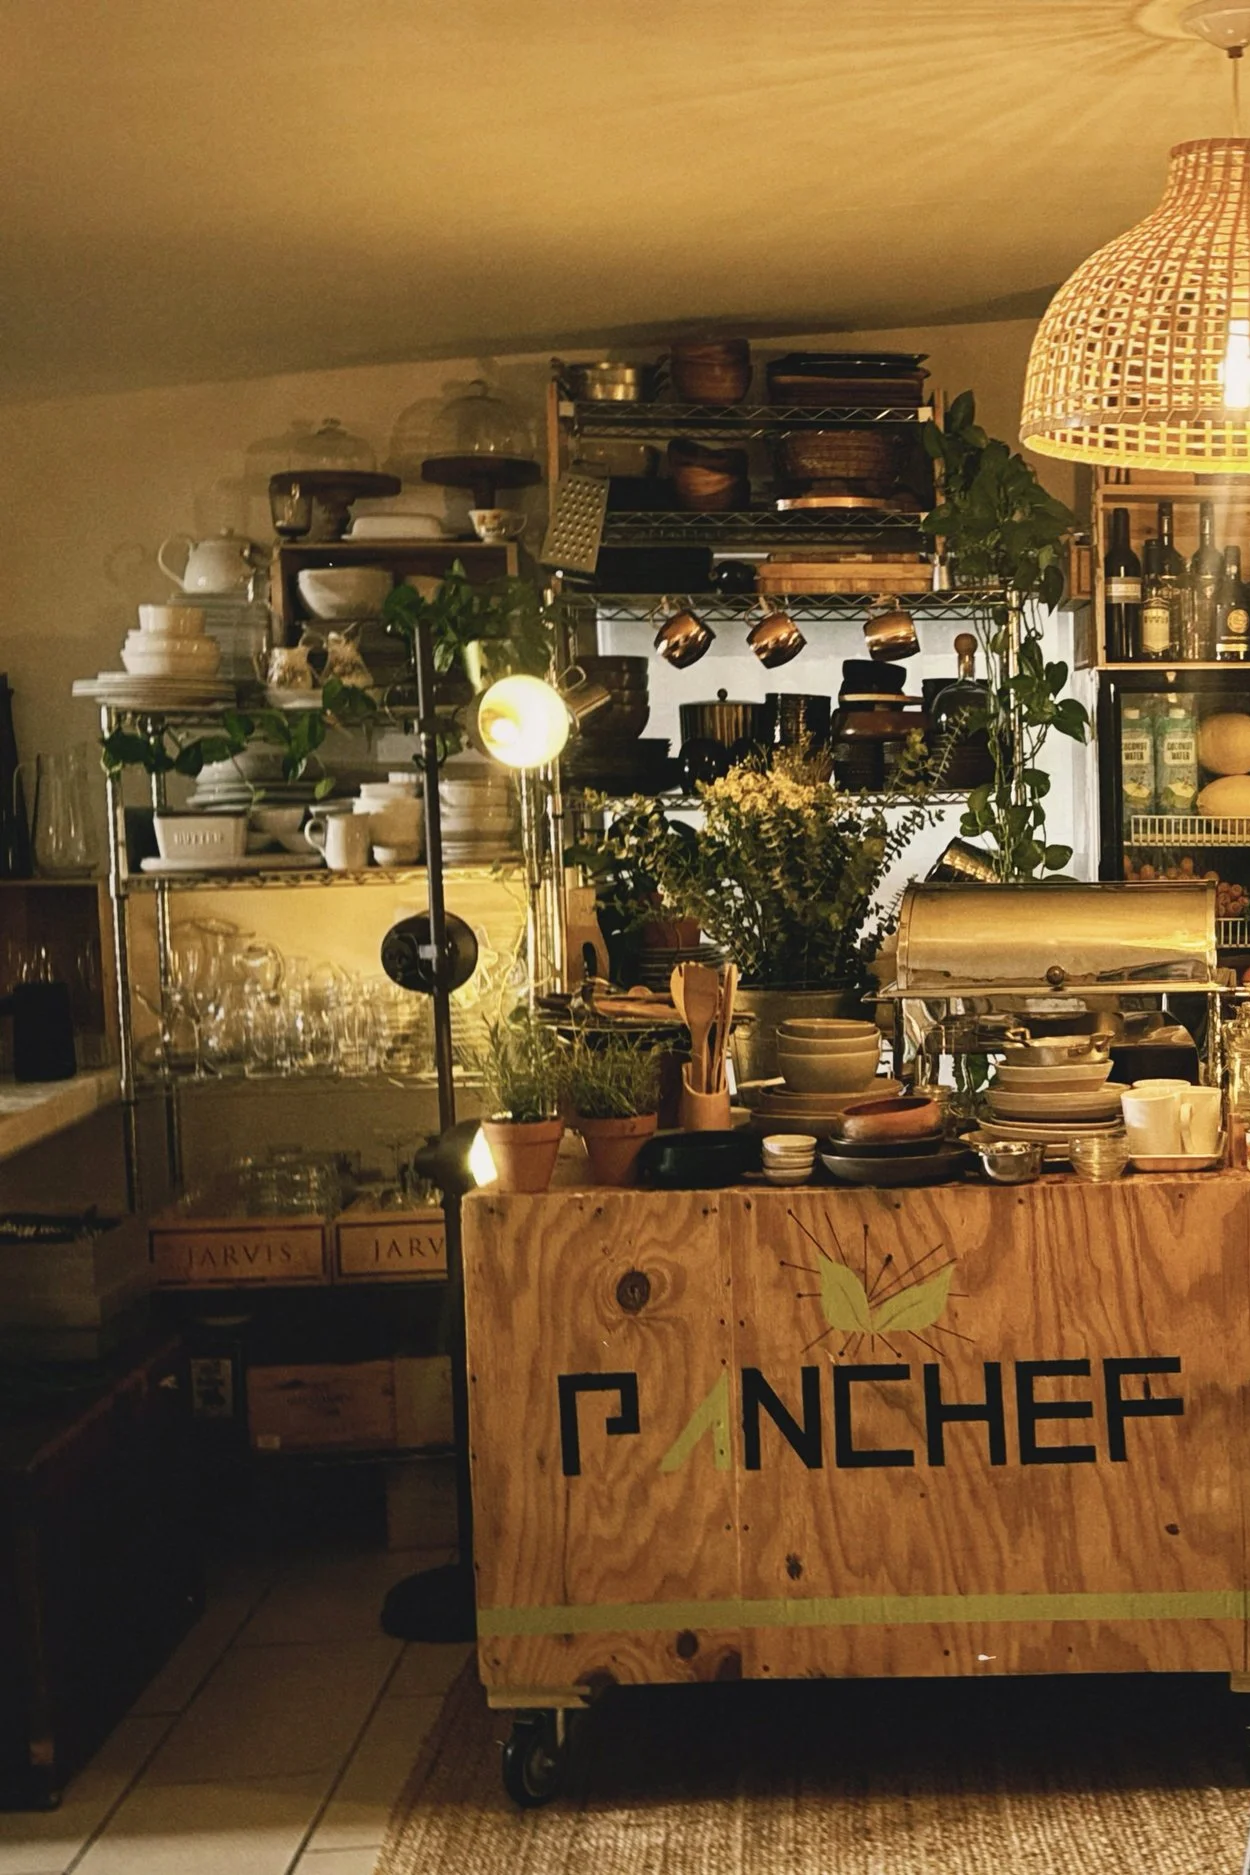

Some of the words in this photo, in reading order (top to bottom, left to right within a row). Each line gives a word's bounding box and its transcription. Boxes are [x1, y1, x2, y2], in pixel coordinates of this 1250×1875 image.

[189, 1242, 293, 1267] JARVIS
[374, 1237, 444, 1262] JARV
[557, 1356, 1185, 1476] PANCHEF
